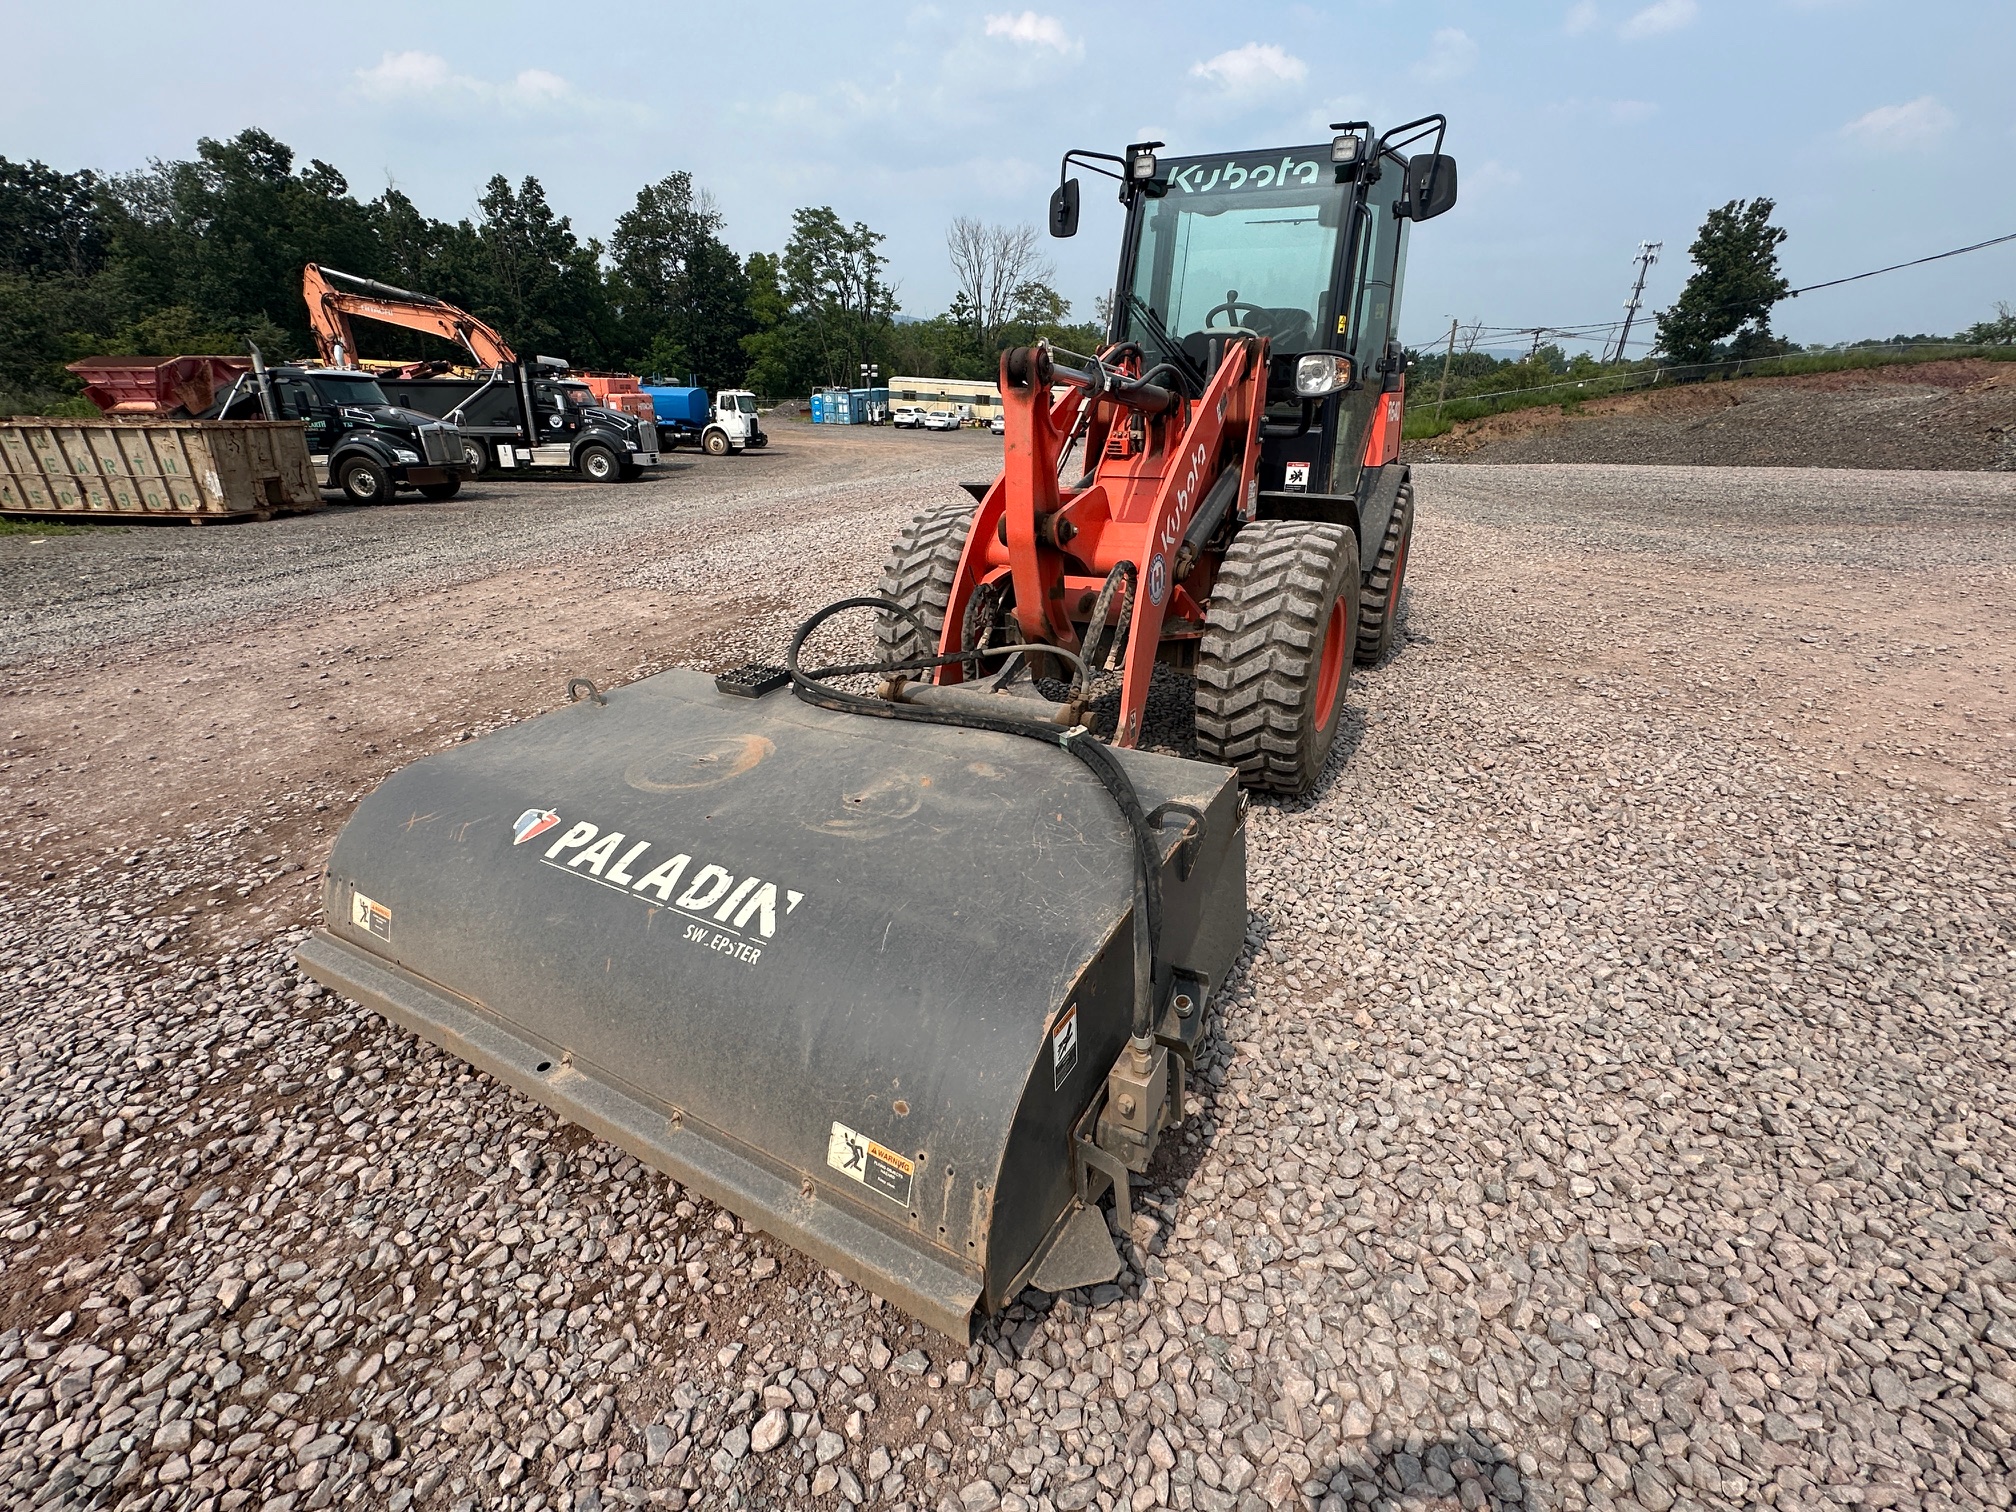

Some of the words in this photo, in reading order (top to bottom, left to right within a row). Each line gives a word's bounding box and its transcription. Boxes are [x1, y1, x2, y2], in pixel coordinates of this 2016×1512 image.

[1166, 156, 1320, 193] Kubota
[44, 457, 178, 475] EARTH
[1161, 443, 1207, 553] Kubota
[543, 820, 806, 940] PALADIN
[682, 923, 762, 966] SWEPSTER
